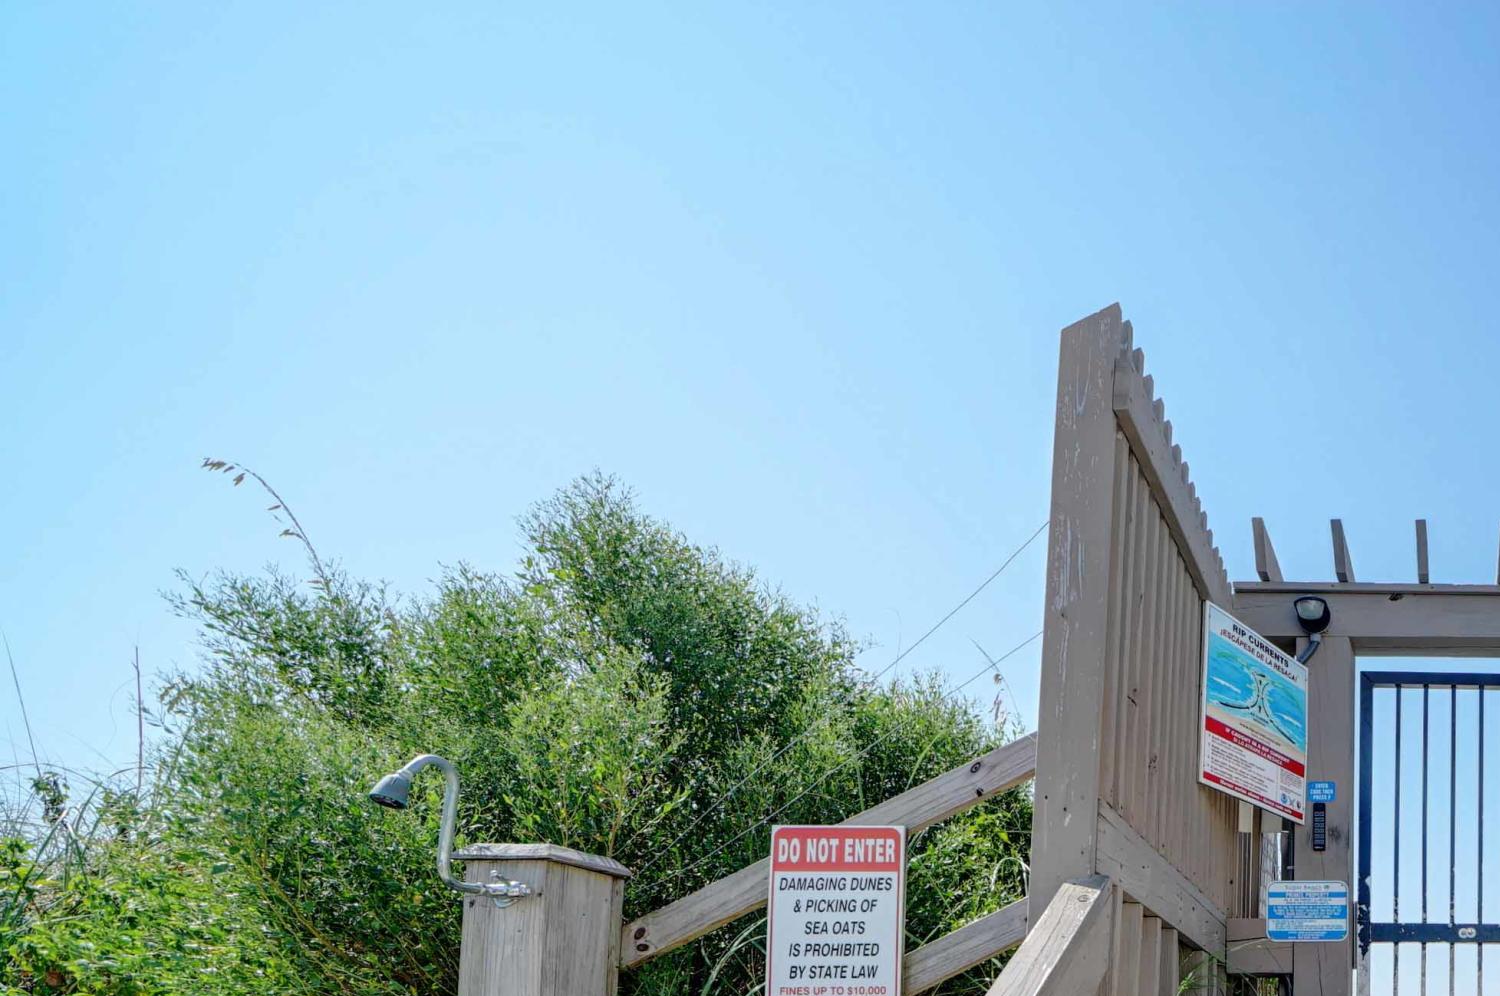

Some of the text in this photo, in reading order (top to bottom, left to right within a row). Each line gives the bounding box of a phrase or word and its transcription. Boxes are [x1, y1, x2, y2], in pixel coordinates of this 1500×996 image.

[1232, 624, 1289, 668] RIP CURRENTS
[1256, 652, 1264, 660] DE
[1265, 656, 1272, 666] LA
[778, 838, 895, 863] DO NOT ENTER
[779, 877, 892, 891] DAMAGING DUNES
[793, 899, 878, 913] & PICKING OF
[804, 921, 865, 935] SEA OATS
[789, 943, 879, 957] IS PROHIBITED
[789, 965, 879, 979] BY STATE LAW
[779, 987, 810, 995] FINES
[813, 987, 827, 995] UP
[830, 986, 844, 995] TO
